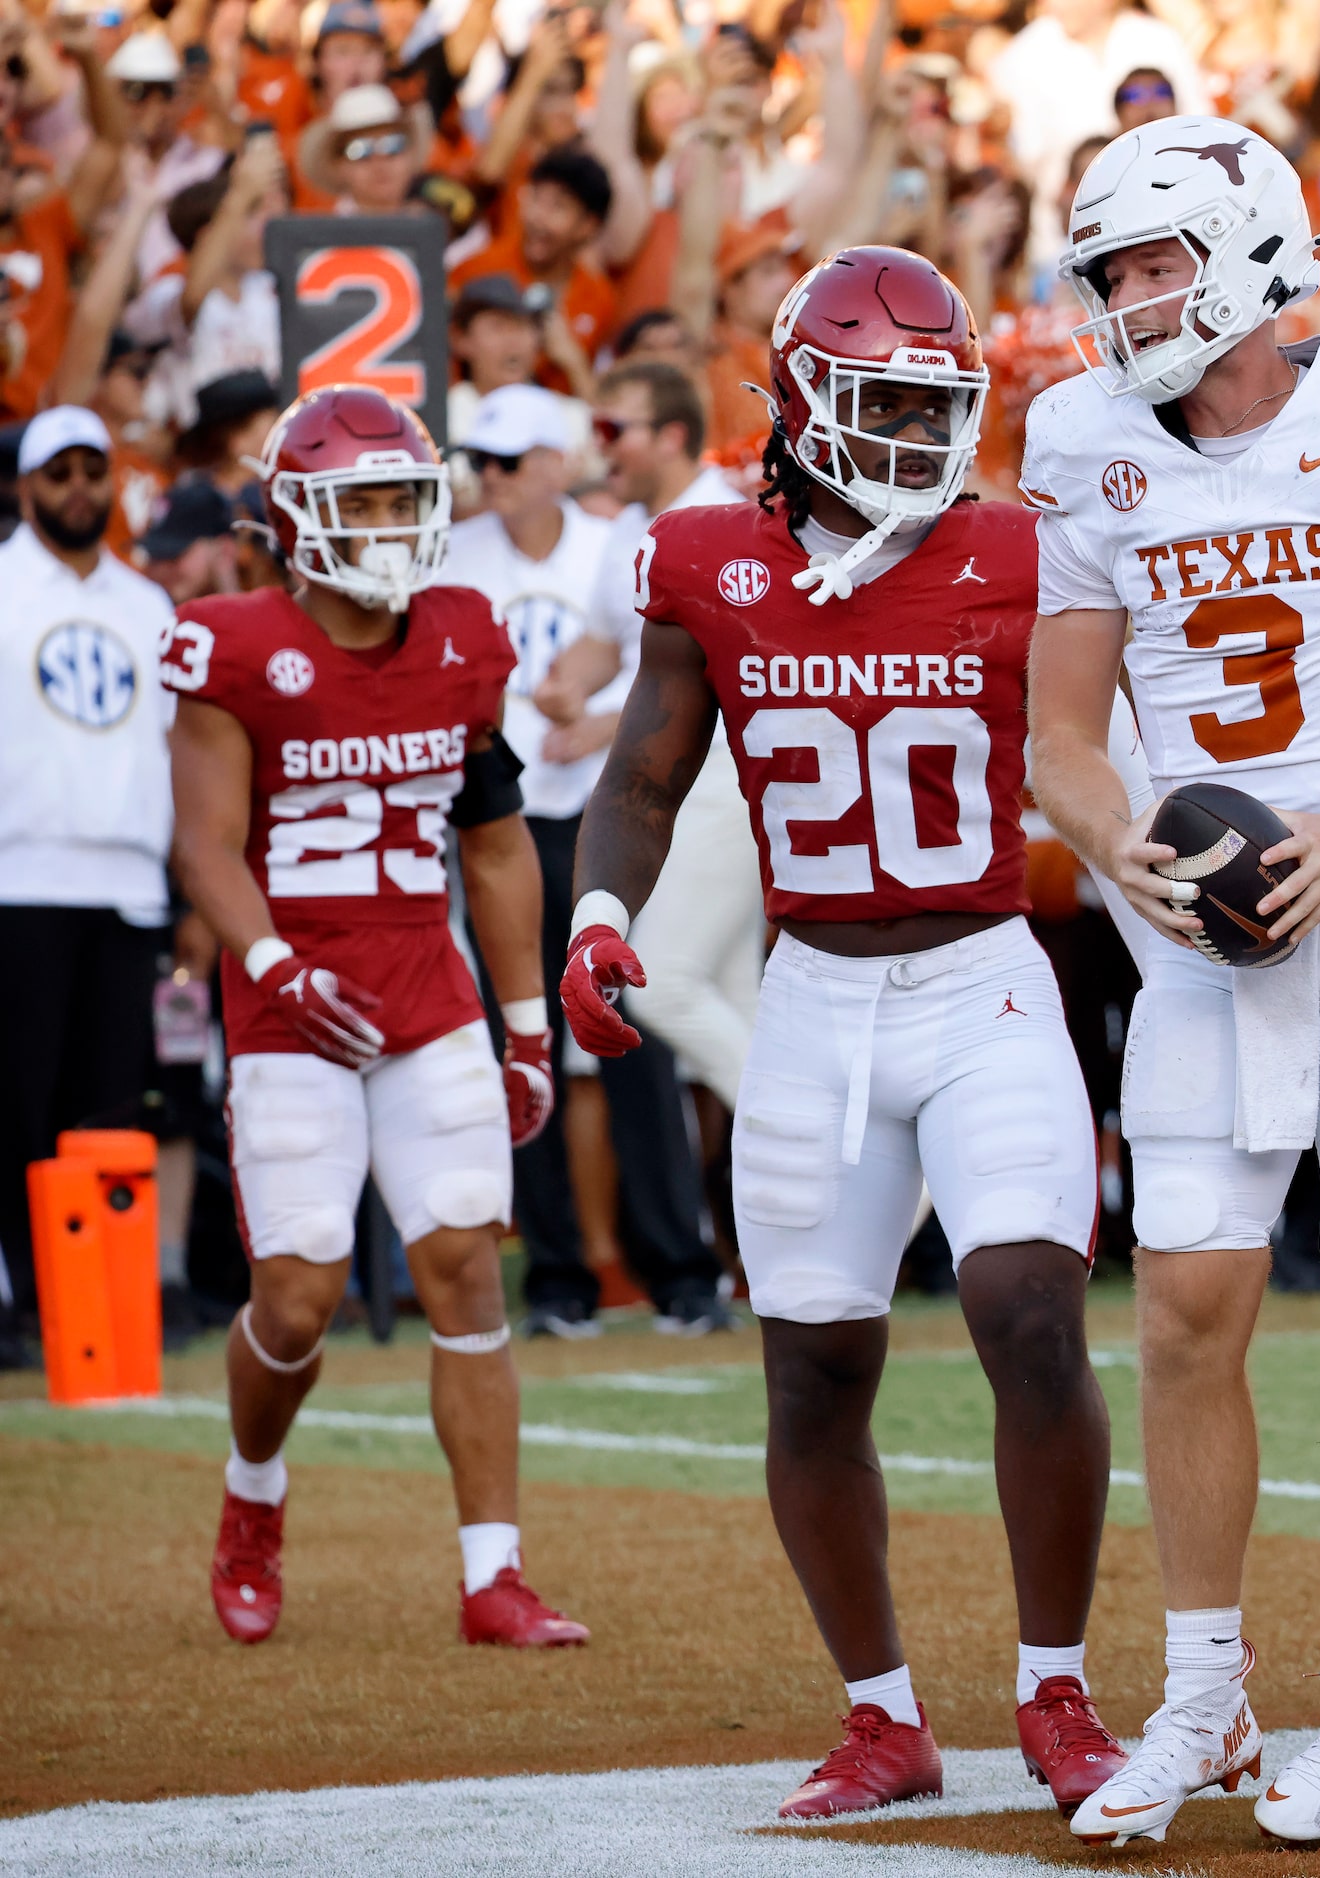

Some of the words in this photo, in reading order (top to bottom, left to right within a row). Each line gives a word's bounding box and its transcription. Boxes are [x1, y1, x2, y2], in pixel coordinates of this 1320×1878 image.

[296, 246, 426, 410] 2
[907, 354, 946, 366] OKLAHOMA
[1102, 461, 1147, 511] SEC
[719, 559, 770, 606] SEC
[37, 624, 136, 726] SEC
[267, 648, 315, 696] SEC
[738, 653, 984, 698] SOONERS
[1181, 593, 1306, 764] 3
[281, 723, 468, 780] SOONERS
[741, 706, 995, 895] 20
[264, 769, 465, 898] 23
[1223, 1698, 1252, 1764] NIKE
